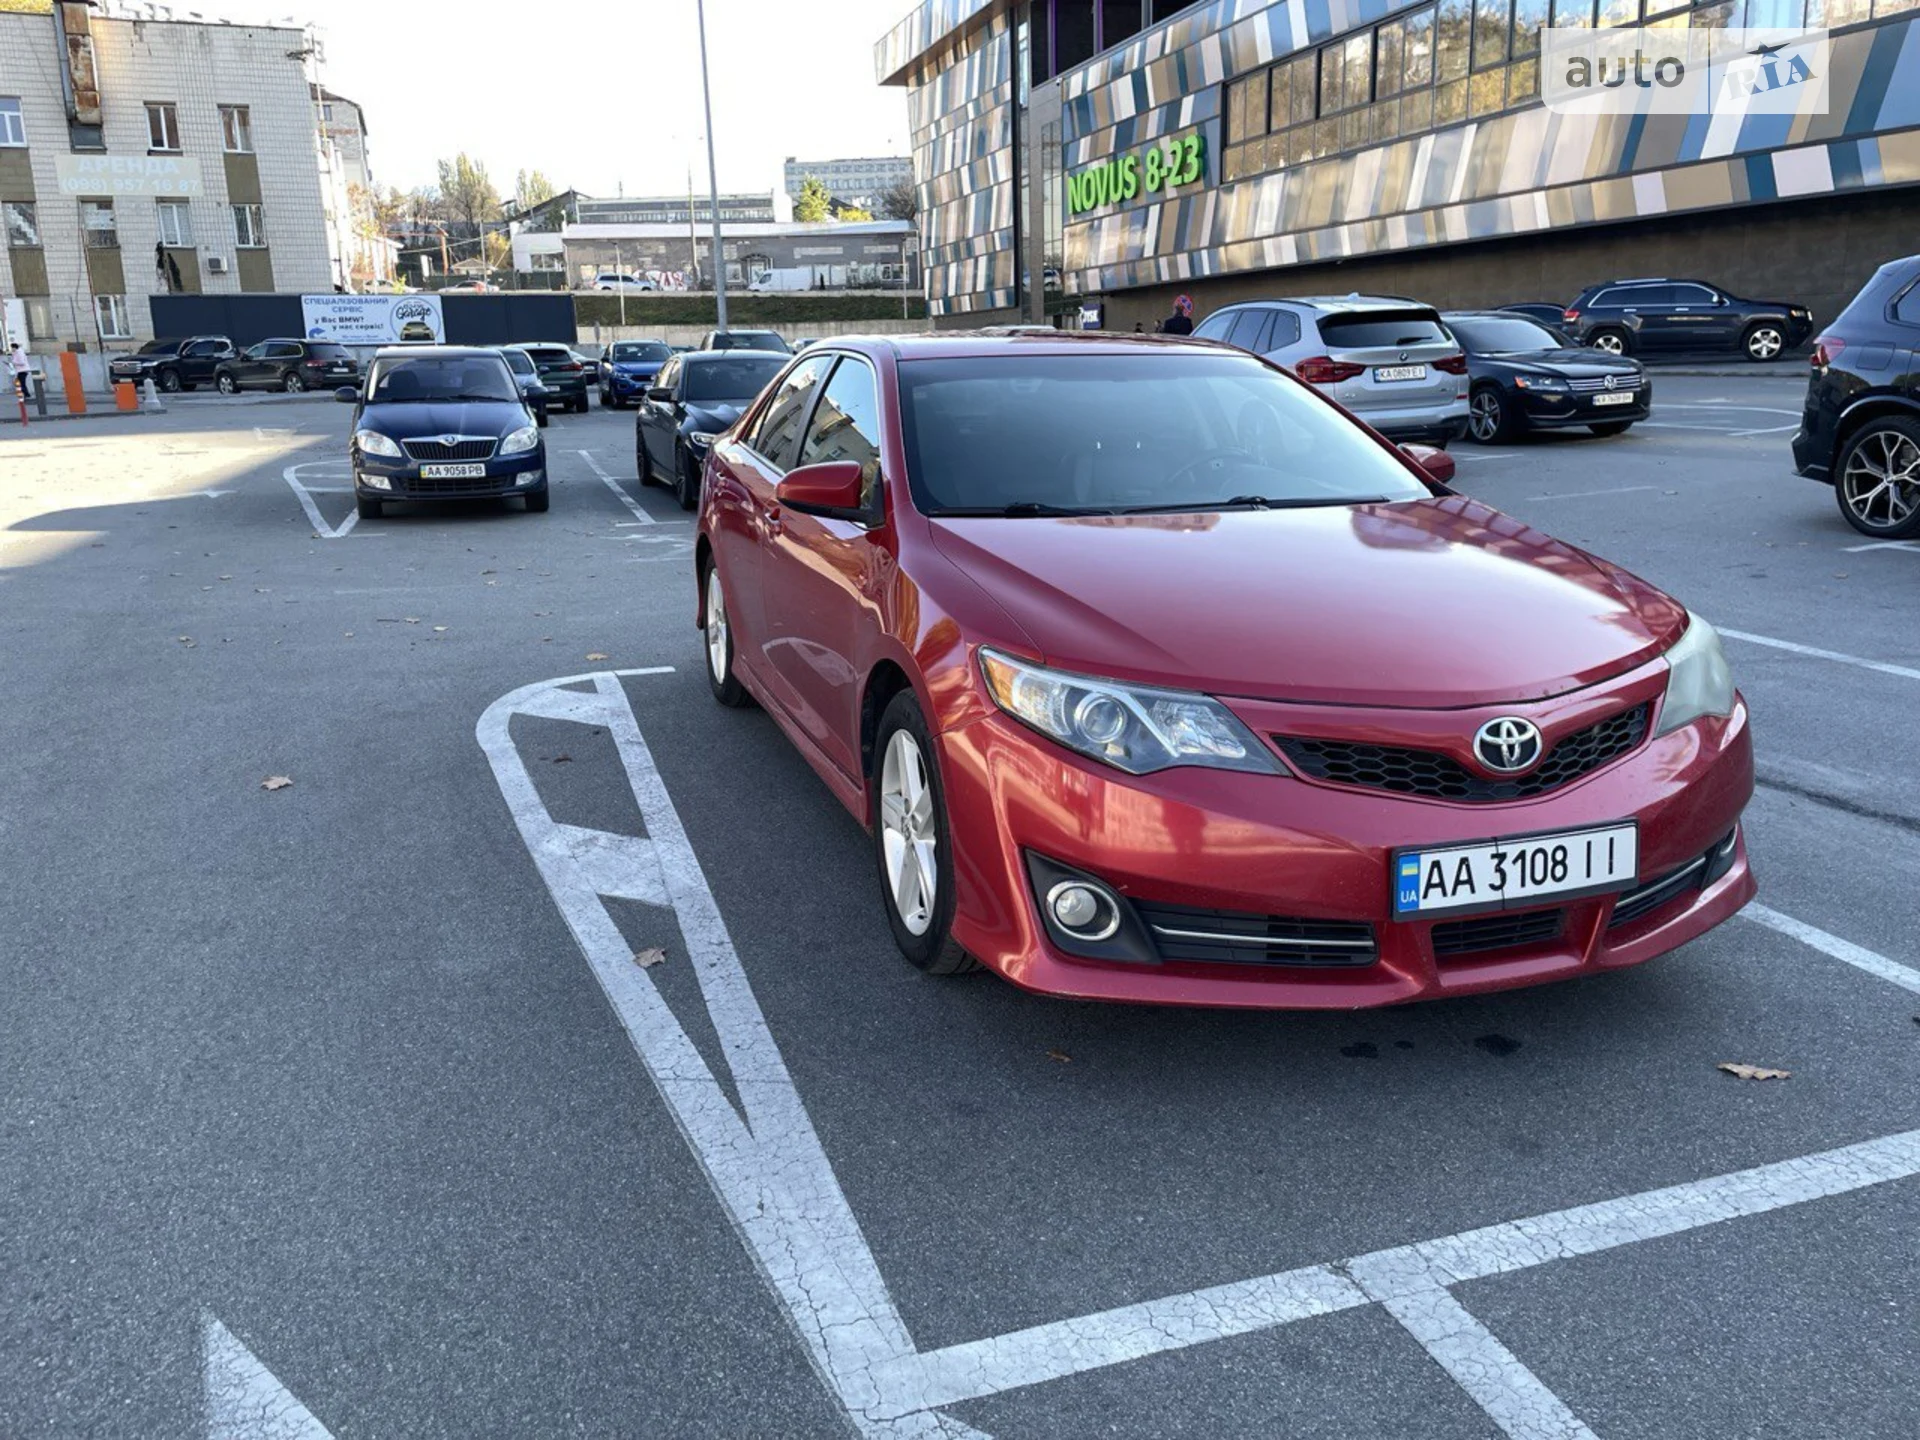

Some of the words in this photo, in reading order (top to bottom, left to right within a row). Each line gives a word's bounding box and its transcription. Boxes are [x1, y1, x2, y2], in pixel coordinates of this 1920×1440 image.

[78, 157, 180, 176] АРЕНДА
[1068, 155, 1138, 215] NOVUS
[1145, 134, 1204, 193] 8-23
[61, 178, 108, 194] (098)
[113, 178, 145, 192] 957
[151, 179, 173, 192] 16
[179, 179, 199, 193] 87
[428, 466, 442, 476] AA
[1422, 857, 1476, 899] AA
[1488, 845, 1568, 891] 3108
[1401, 890, 1417, 903] UA
